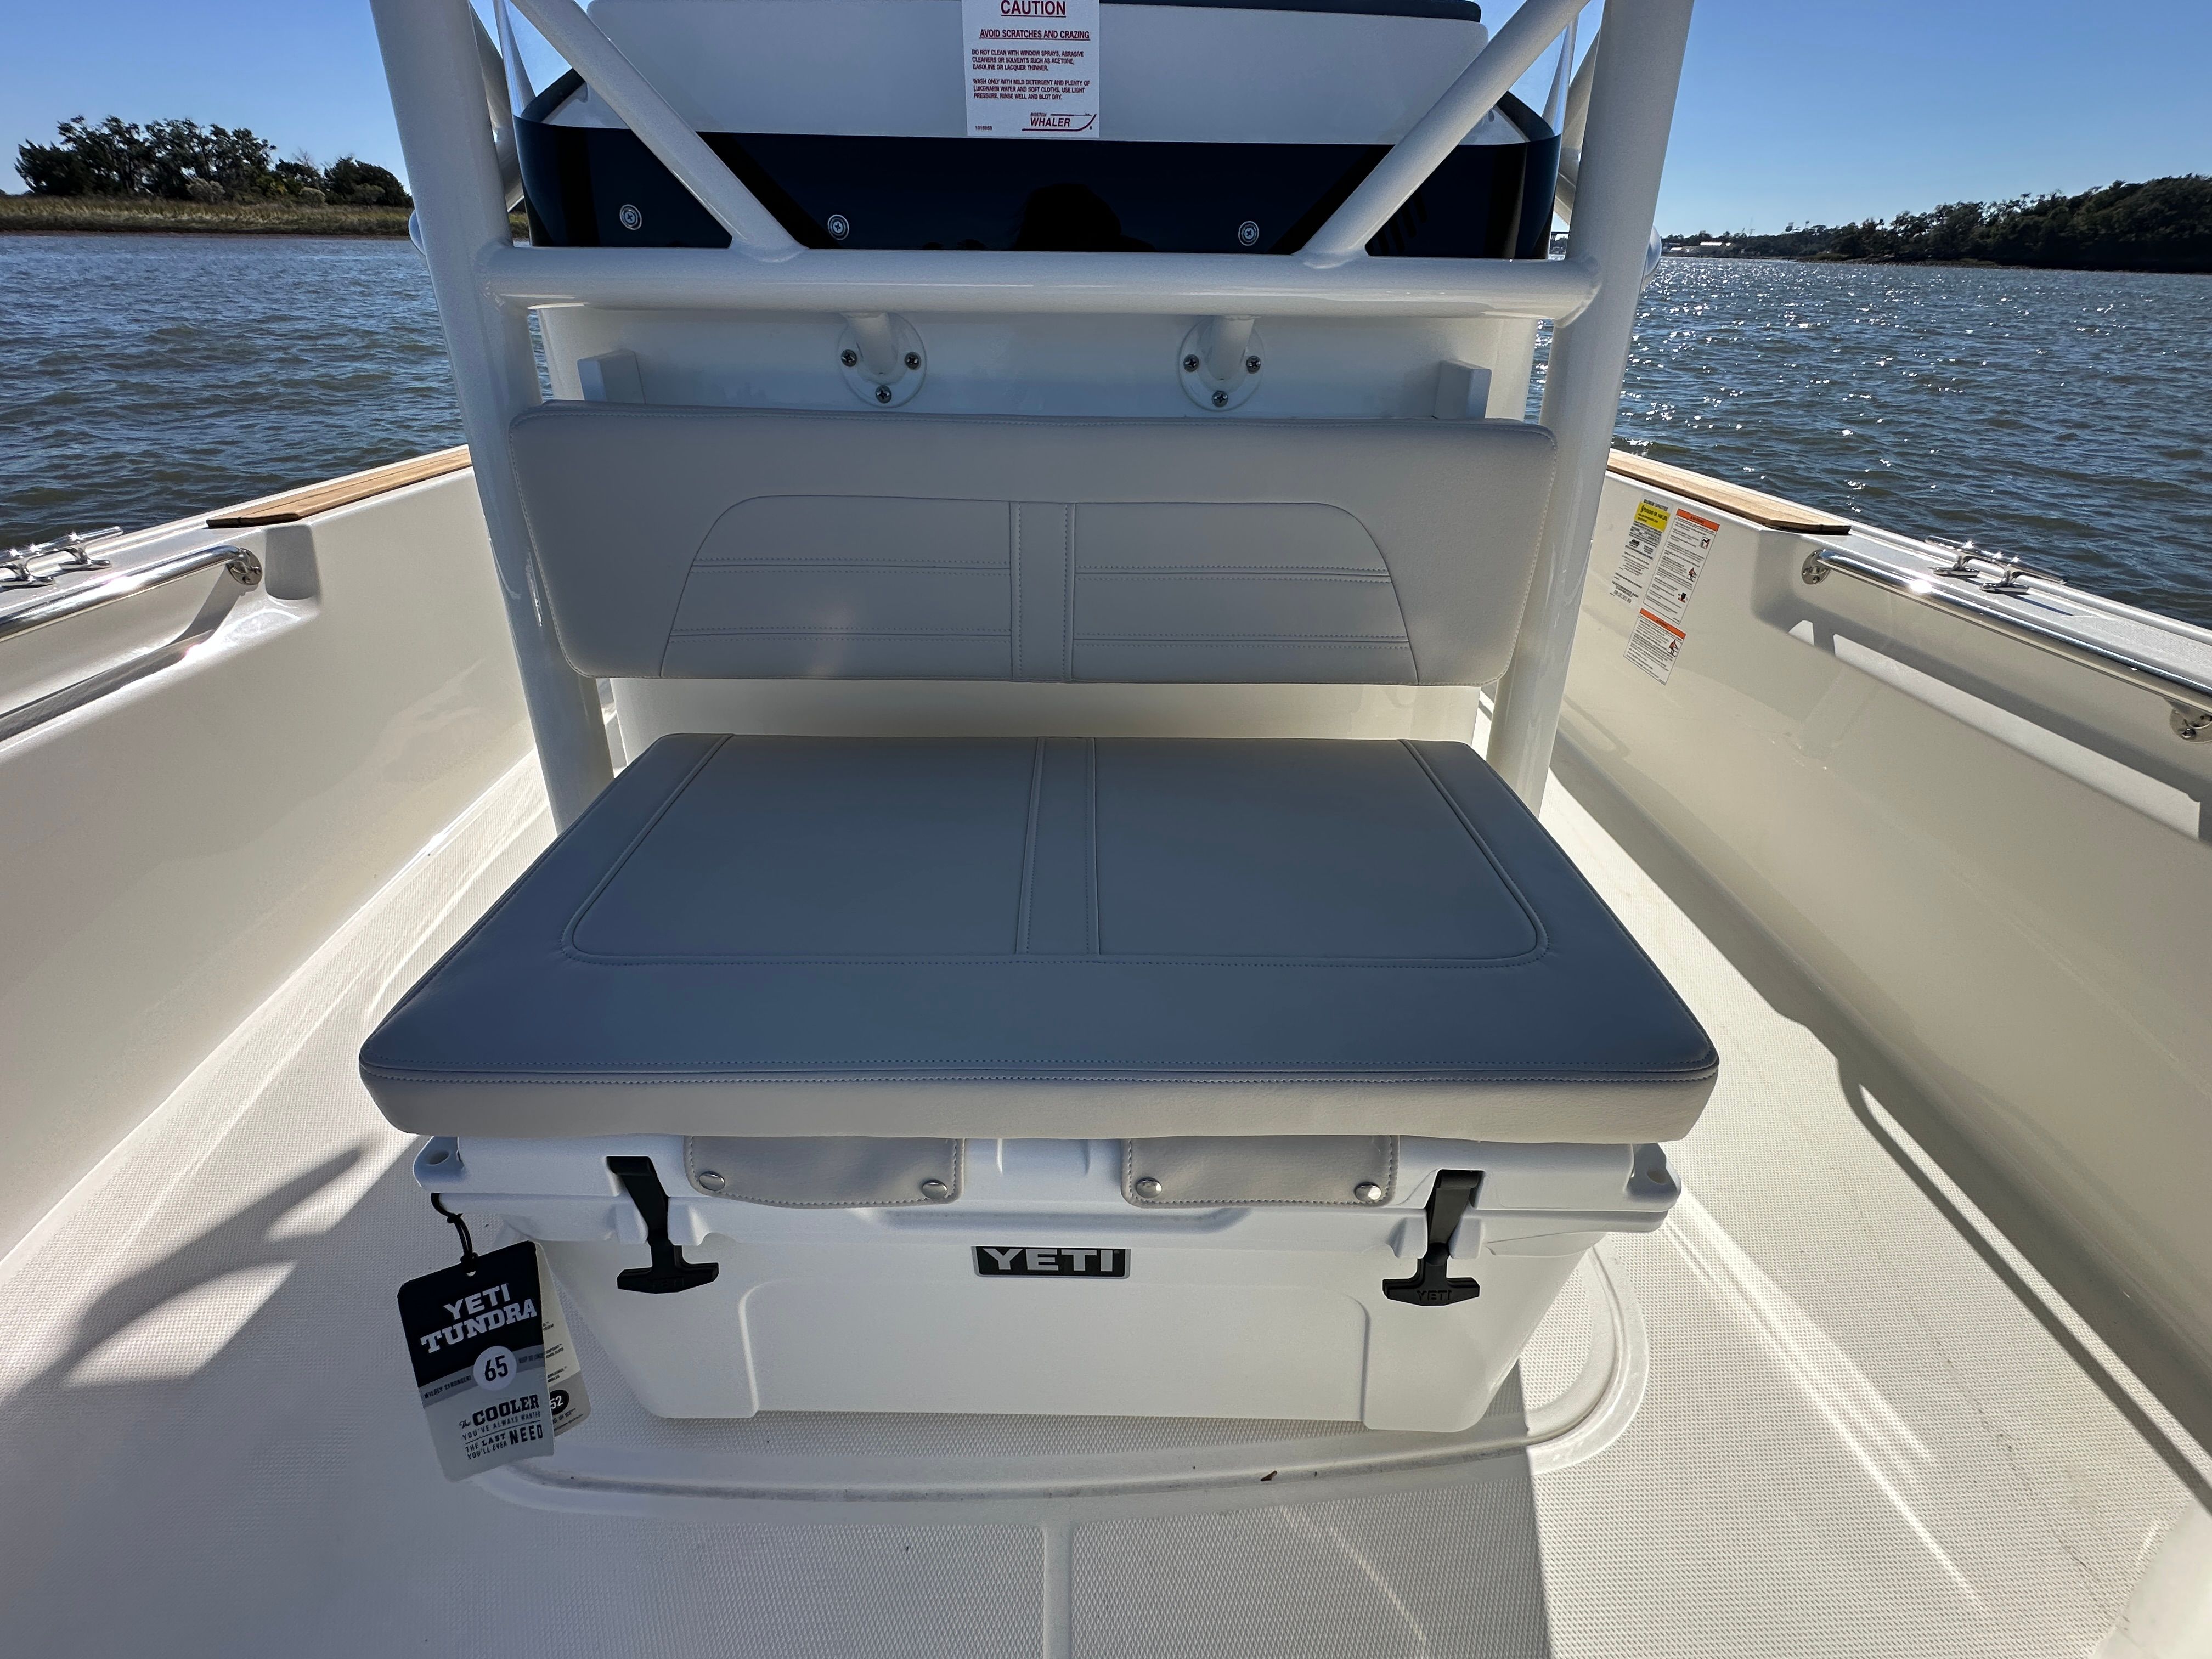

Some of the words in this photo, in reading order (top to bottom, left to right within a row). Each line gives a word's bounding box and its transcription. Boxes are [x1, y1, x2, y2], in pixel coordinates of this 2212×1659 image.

[1001, 0, 1065, 15] CAUTION
[980, 29, 1000, 37] AVOID
[1002, 30, 1042, 38] SCRATCHES
[1043, 30, 1058, 38] AND
[1060, 31, 1090, 39] CRAZING
[1030, 117, 1071, 127] WHALER
[983, 1248, 1113, 1272] YETI
[443, 1283, 511, 1320] YETI
[1417, 1290, 1452, 1301] YETI
[420, 1299, 537, 1353] TUNDRA
[484, 1355, 508, 1382] 65
[459, 1418, 471, 1430] The
[472, 1394, 539, 1426] COOLER
[462, 1425, 490, 1441] YOU'VE
[493, 1416, 518, 1429] ALWAYS
[522, 1410, 540, 1420] WANTED
[509, 1424, 543, 1445] NEED
[465, 1442, 478, 1453] THE
[482, 1432, 505, 1447] LAST
[467, 1448, 490, 1460] YOU'LL
[493, 1440, 507, 1451] EVER
